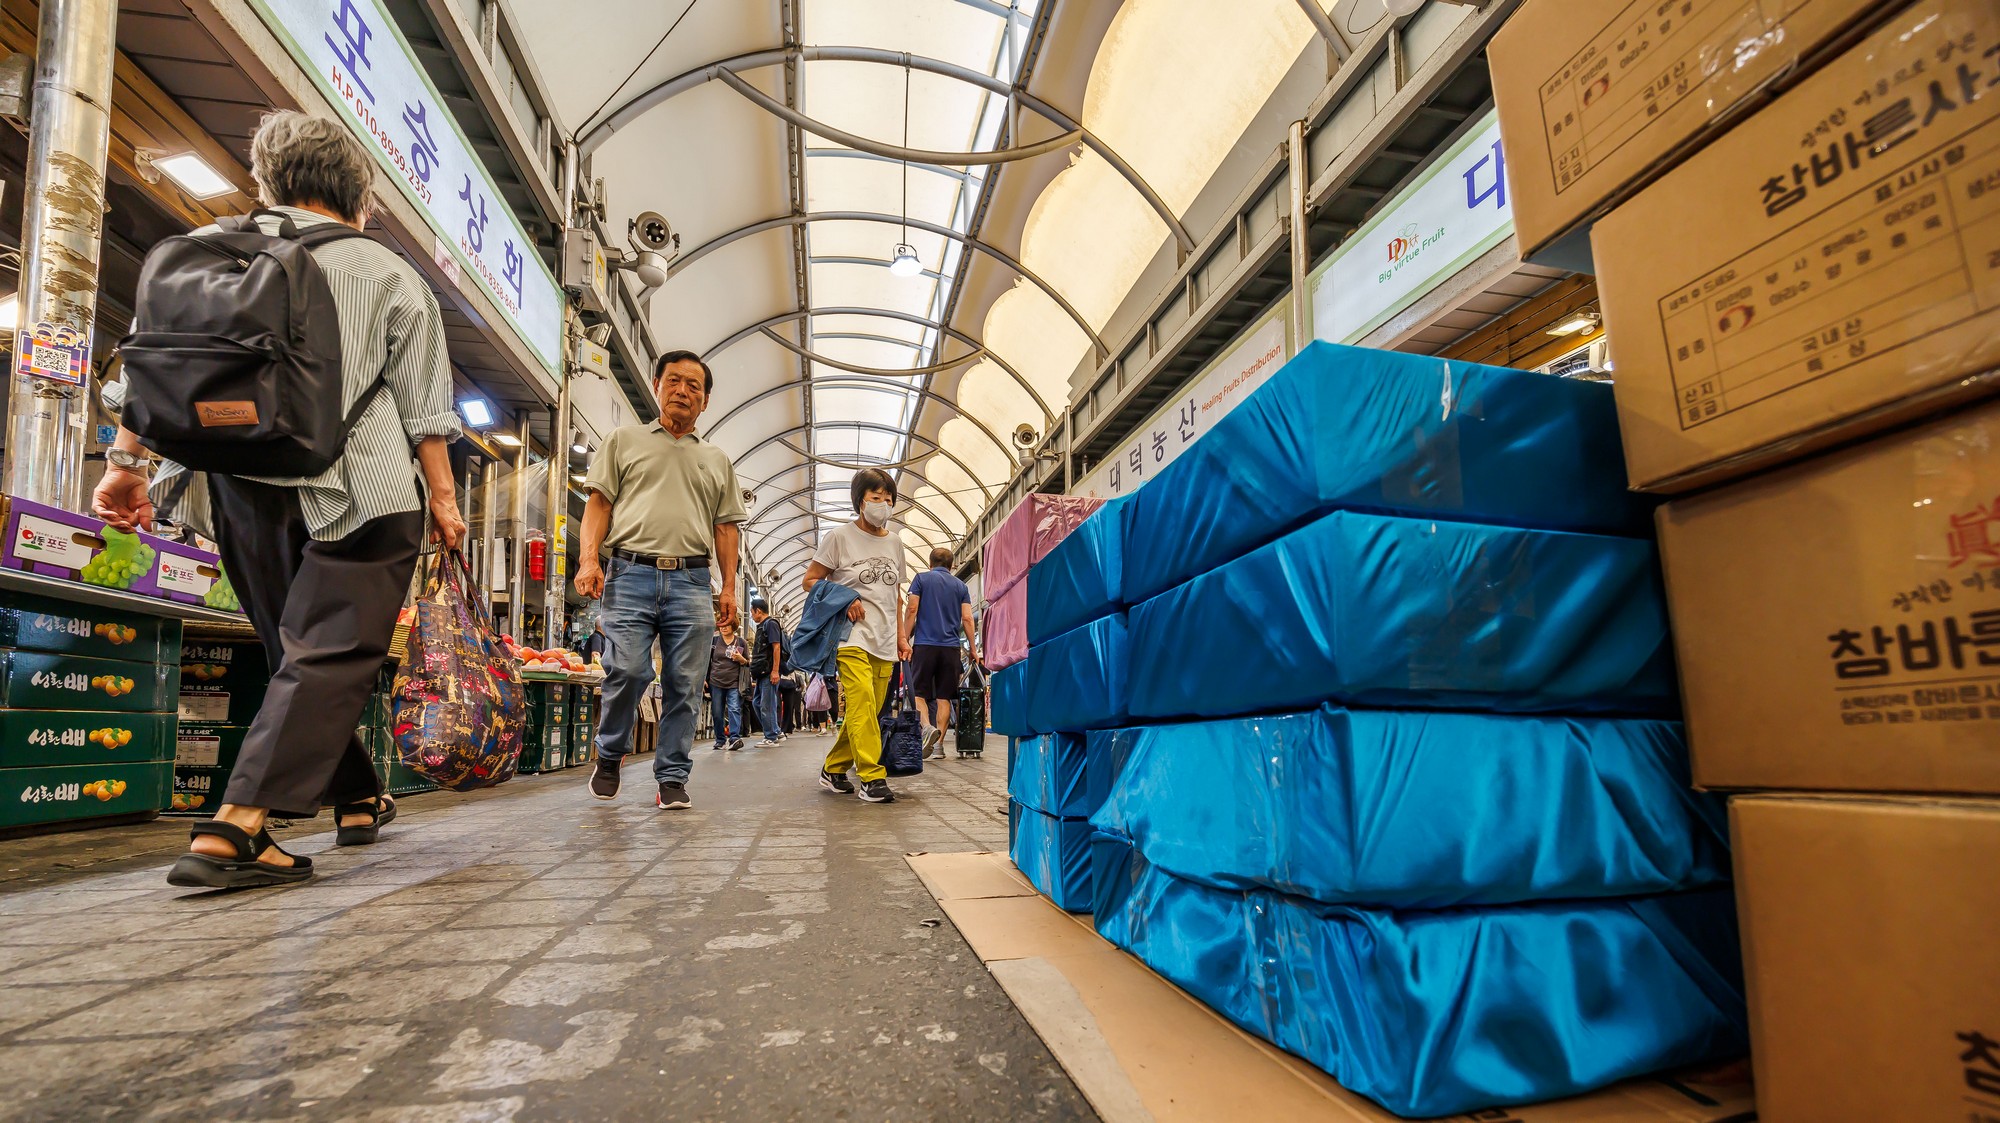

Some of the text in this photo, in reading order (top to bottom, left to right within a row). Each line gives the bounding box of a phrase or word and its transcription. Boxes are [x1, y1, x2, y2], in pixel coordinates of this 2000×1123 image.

[332, 65, 432, 205] H.P 010-8959-2357
[1378, 226, 1446, 284] Big virtue Fruit
[1201, 344, 1281, 414] Healing Fruits Distribution
[46, 537, 68, 552] 포도
[179, 570, 194, 582] 포도
